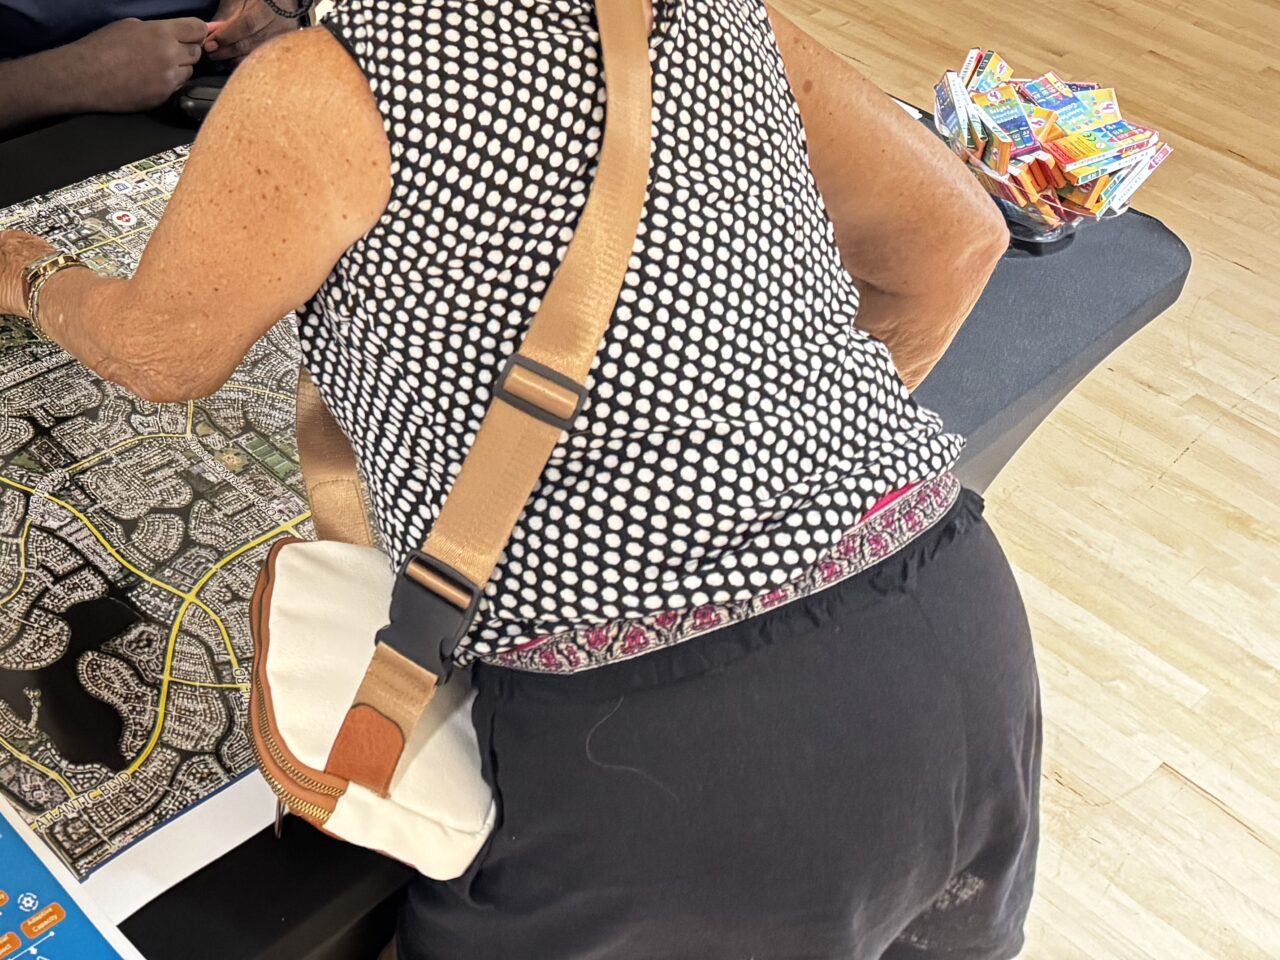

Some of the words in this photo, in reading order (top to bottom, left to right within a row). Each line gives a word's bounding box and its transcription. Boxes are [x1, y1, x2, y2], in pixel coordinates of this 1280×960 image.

[213, 461, 252, 495] SPRINGS
[35, 790, 98, 829] ATLANTIC
[98, 771, 132, 800] BLVD
[31, 913, 58, 933] Capacity
